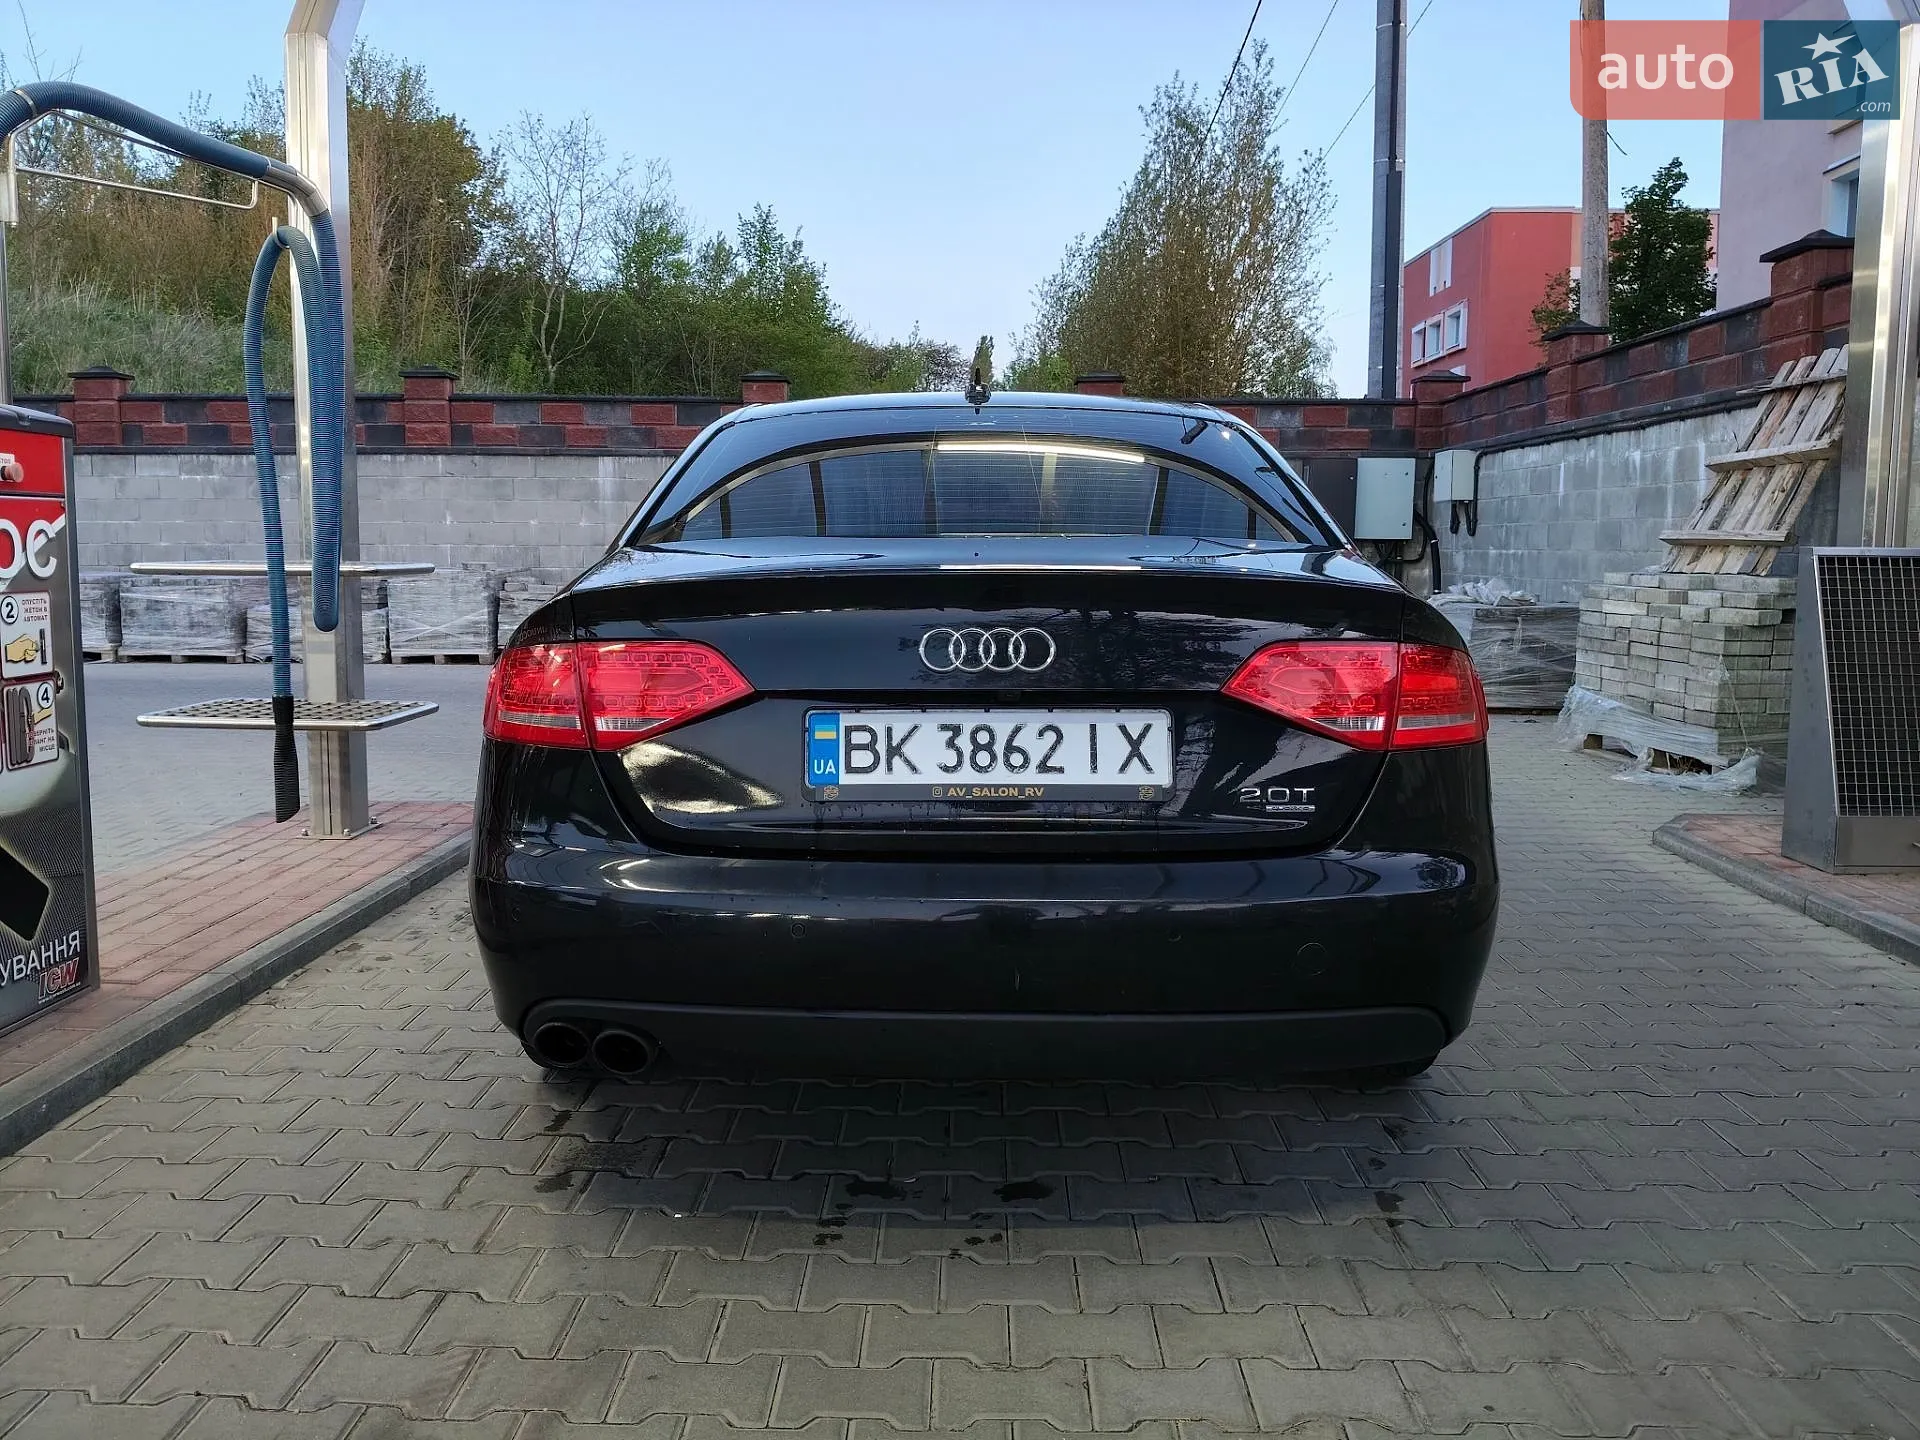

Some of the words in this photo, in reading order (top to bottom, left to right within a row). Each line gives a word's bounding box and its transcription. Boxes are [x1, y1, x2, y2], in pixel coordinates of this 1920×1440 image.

[5, 601, 15, 619] 2
[41, 687, 50, 703] 4
[844, 723, 922, 775] BK
[936, 723, 1065, 775] 3862
[814, 759, 836, 775] UA
[947, 786, 1045, 799] AV_SALON_RV
[0, 930, 80, 986] УВАННЯ
